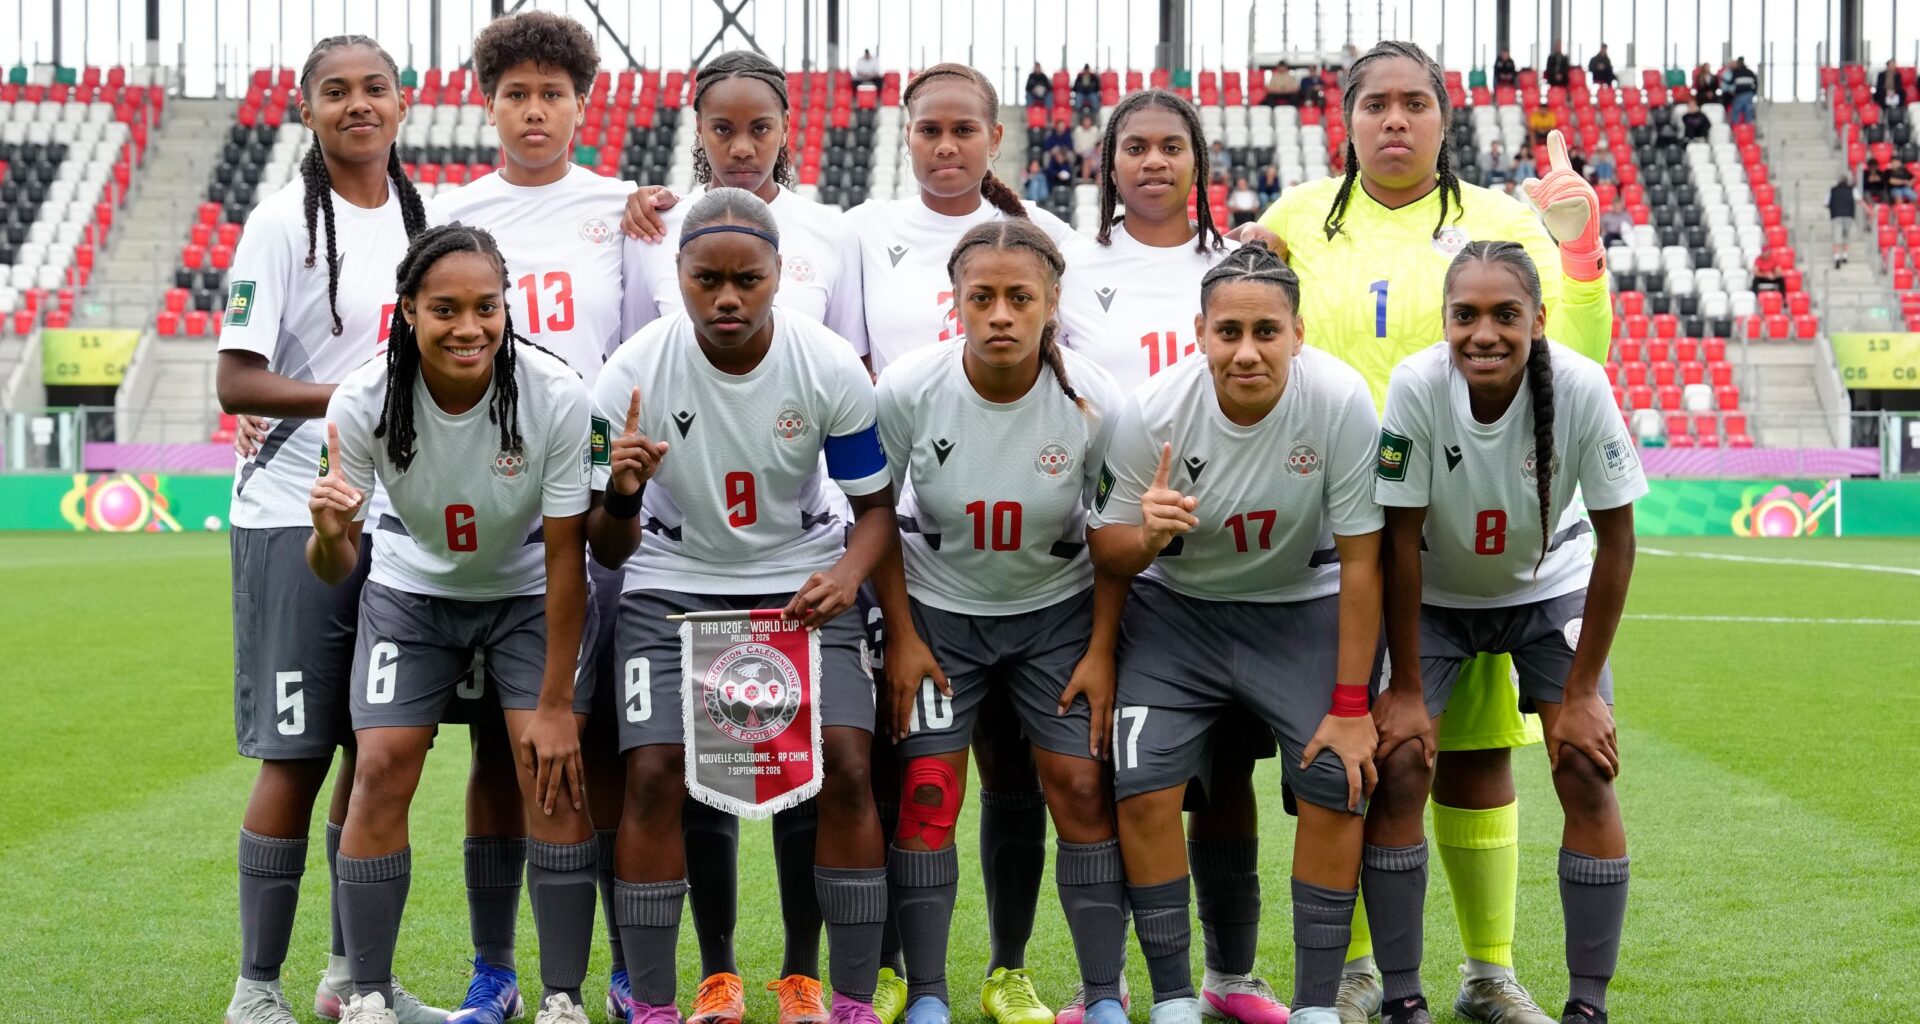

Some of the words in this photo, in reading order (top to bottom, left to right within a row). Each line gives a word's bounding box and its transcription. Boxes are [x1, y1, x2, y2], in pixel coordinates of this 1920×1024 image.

[518, 271, 575, 334] 13
[1369, 279, 1389, 338] 1
[1868, 338, 1891, 353] 13
[1893, 366, 1918, 380] C6
[724, 471, 758, 529] 9
[444, 504, 478, 552] 6
[965, 500, 1023, 551] 10
[1224, 509, 1277, 553] 17
[1474, 509, 1507, 555] 8
[700, 623, 719, 634] FIFA
[721, 621, 743, 634] U20F
[750, 620, 780, 632] WORLD
[782, 619, 800, 631] CUP
[731, 634, 754, 643] POLOGNE
[755, 633, 770, 642] 2026
[366, 642, 399, 704] 6
[624, 656, 652, 722] 9
[276, 670, 305, 736] 5
[722, 724, 735, 735] DE
[740, 721, 785, 741] FOOTBALL
[1112, 705, 1149, 771] 17
[699, 752, 770, 764] NOUVELLE-CALÉDONIE
[778, 752, 788, 762] RP
[789, 751, 809, 762] CHINE
[732, 766, 765, 776] SEPTEMBRE
[765, 766, 781, 775] 2026
